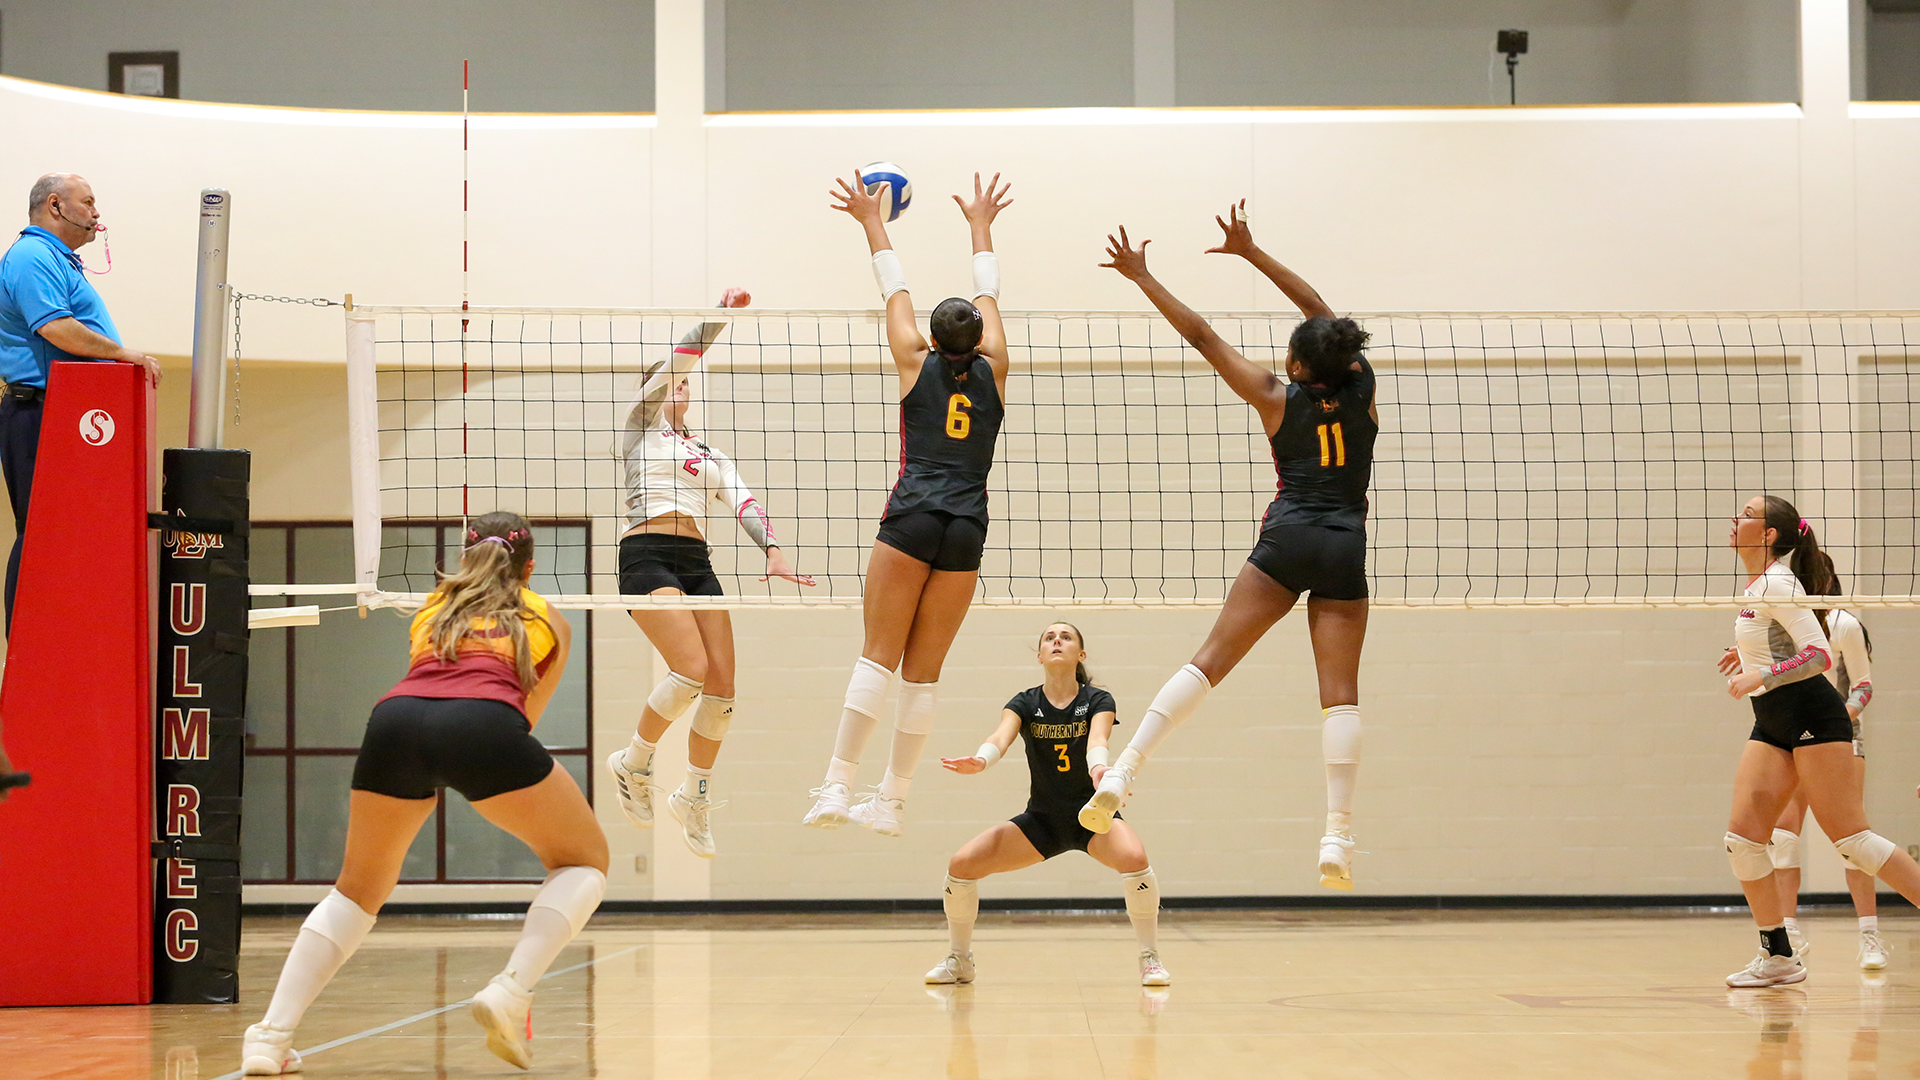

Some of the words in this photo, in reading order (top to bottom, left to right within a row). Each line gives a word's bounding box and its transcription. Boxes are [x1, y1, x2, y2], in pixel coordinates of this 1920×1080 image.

[945, 393, 972, 440] 6
[1317, 422, 1345, 467] 11
[683, 451, 701, 476] 2
[1771, 649, 1816, 676] EAGLES
[1054, 744, 1071, 772] 3
